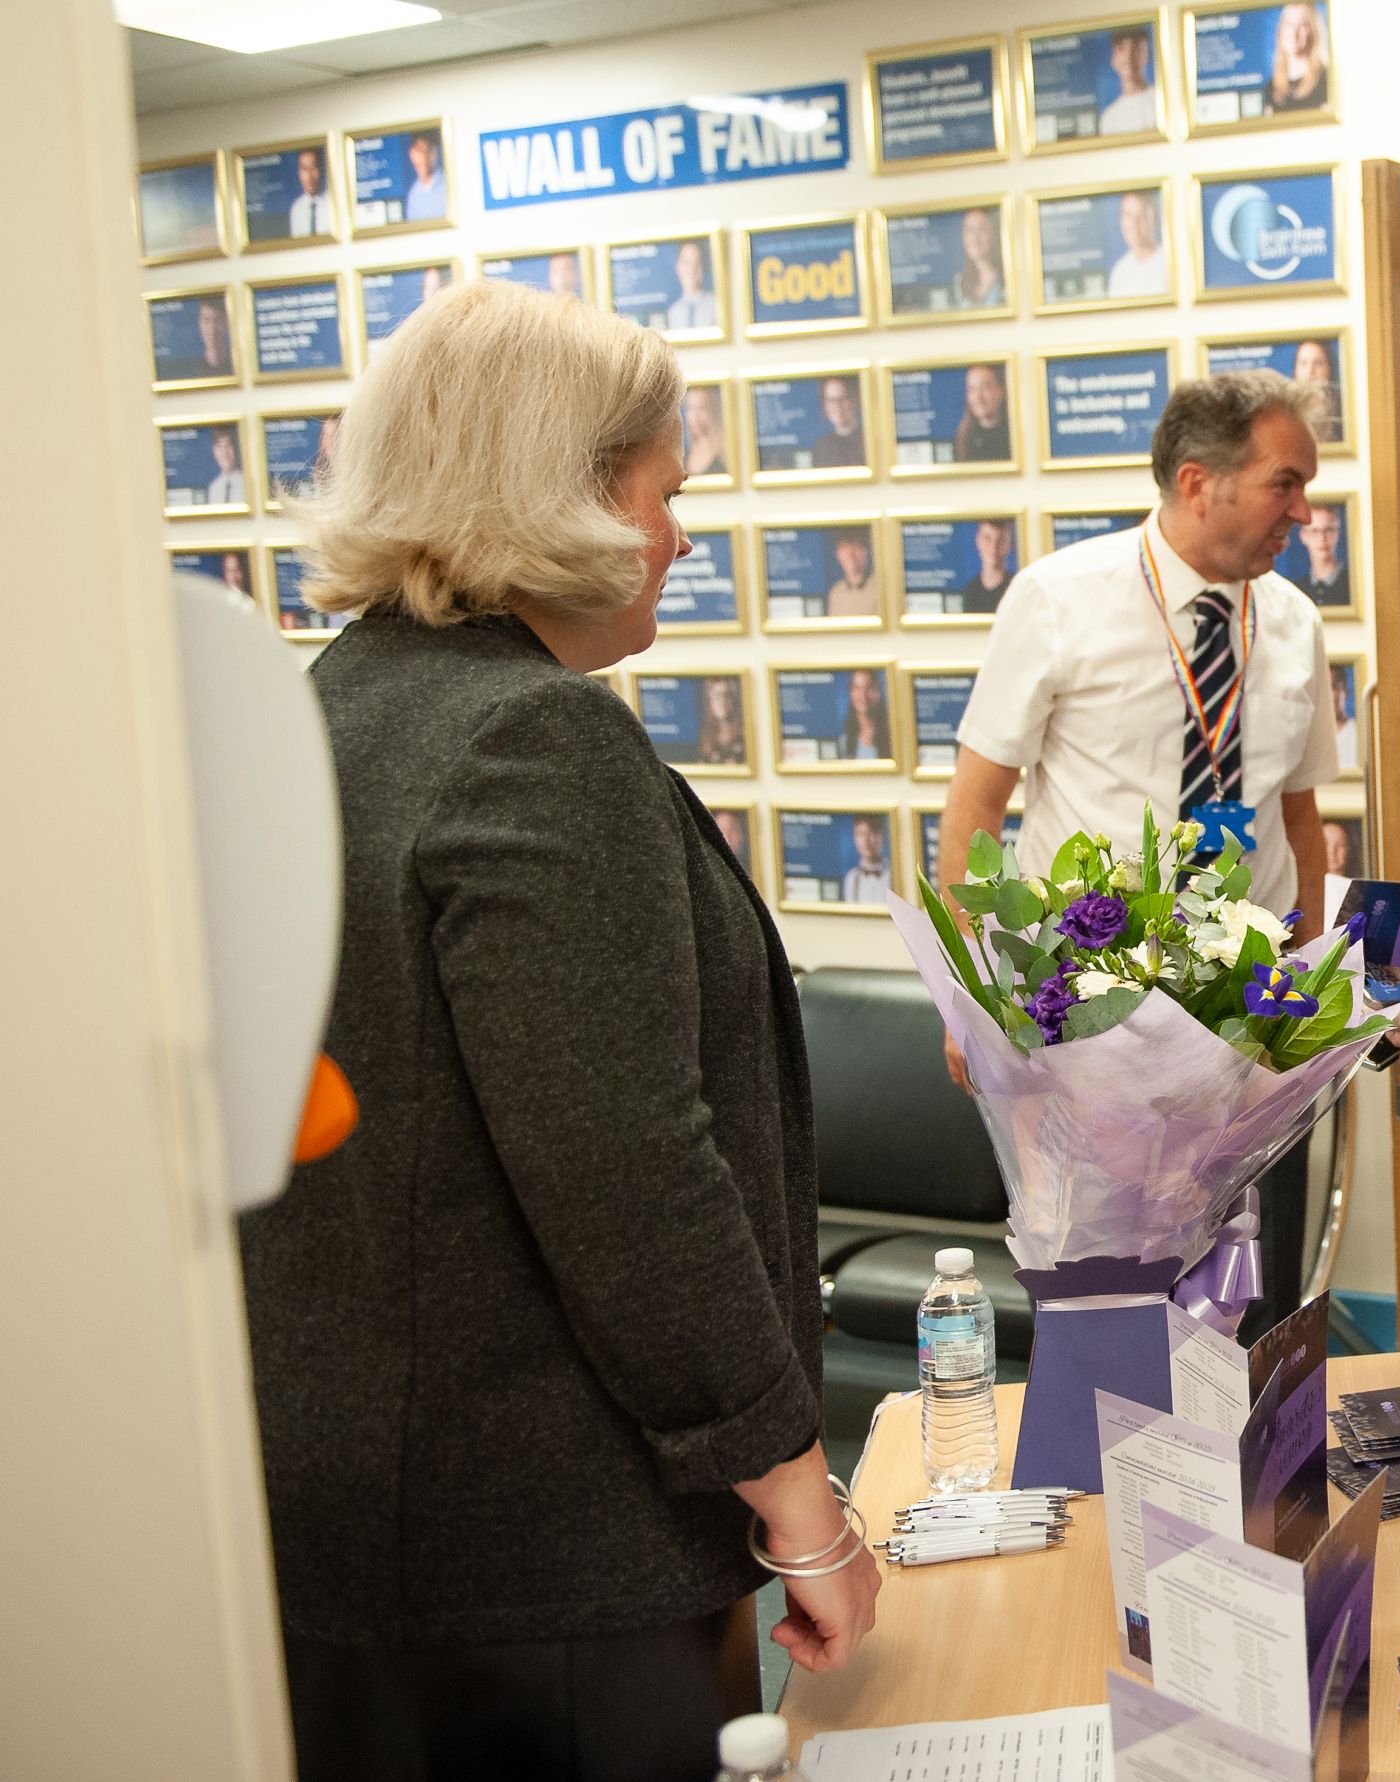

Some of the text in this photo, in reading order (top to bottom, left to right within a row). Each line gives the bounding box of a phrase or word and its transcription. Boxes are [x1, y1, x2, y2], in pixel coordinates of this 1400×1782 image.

[483, 95, 843, 201] WALL OF FAME
[756, 249, 855, 306] Good
[1079, 370, 1156, 393] environment
[1125, 391, 1150, 410] and
